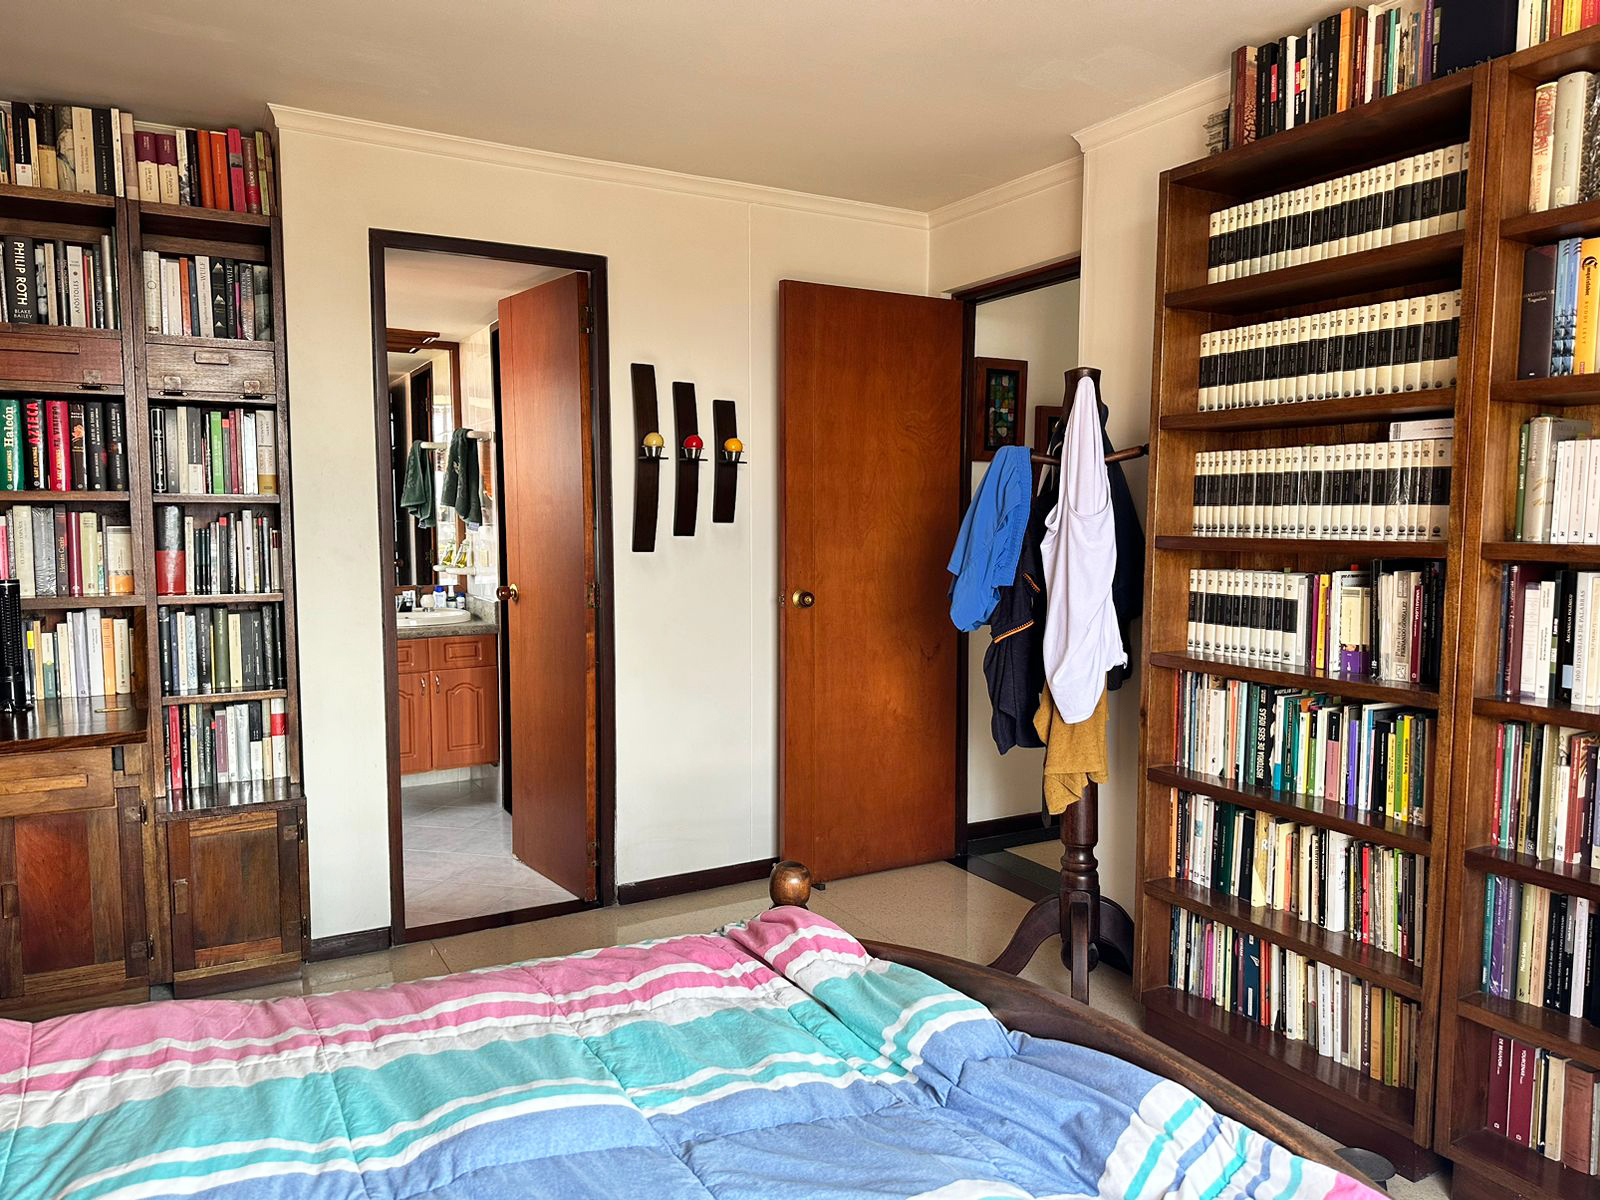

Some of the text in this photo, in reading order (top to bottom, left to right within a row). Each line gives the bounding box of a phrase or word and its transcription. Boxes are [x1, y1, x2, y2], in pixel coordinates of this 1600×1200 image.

[13, 241, 28, 306] PHILIP ROTH
[199, 261, 207, 281] WULF
[2, 406, 14, 448] Halcón
[26, 402, 41, 445] AZTECA
[58, 553, 66, 573] Hernán
[1577, 590, 1586, 624] PALABRAS
[1577, 624, 1584, 634] DE
[1575, 634, 1584, 669] HISTORIAS
[1255, 708, 1267, 779] HISTORIA DE SEIS IDEAS
[1519, 1049, 1527, 1077] YOURCENAR
